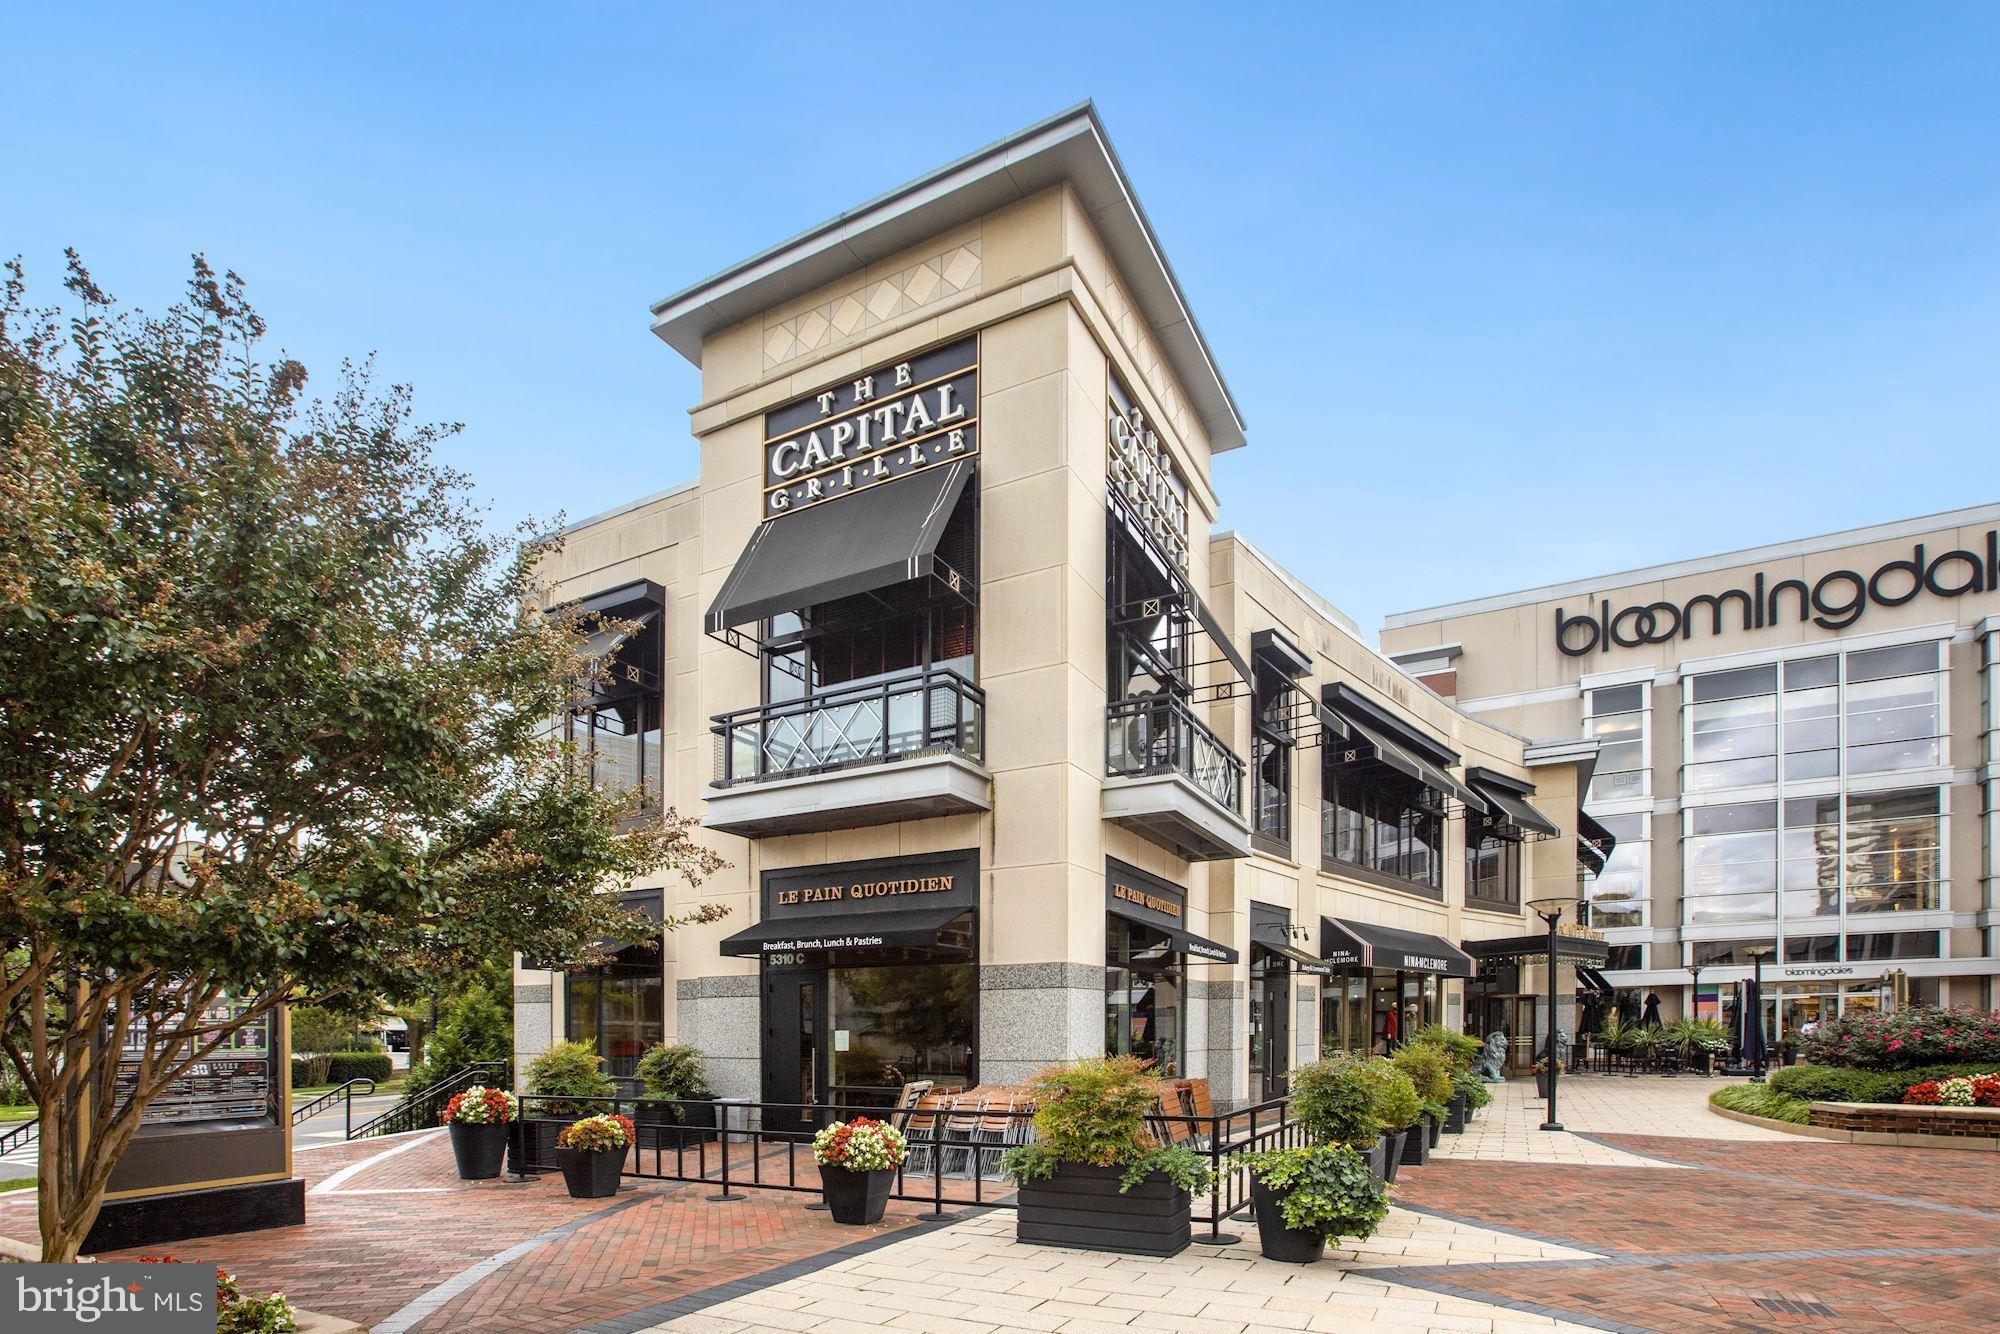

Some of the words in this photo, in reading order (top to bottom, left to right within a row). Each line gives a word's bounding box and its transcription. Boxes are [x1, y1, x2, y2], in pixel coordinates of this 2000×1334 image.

[817, 362, 912, 415] THE
[772, 383, 965, 478] CAPITAL
[1556, 530, 2000, 657] bloomingdal
[778, 891, 799, 905] LE
[803, 886, 844, 902] PAIN
[850, 876, 954, 899] QUOTIDIEN
[1114, 883, 1126, 899] LE
[1127, 887, 1145, 905] PAIN
[1146, 895, 1181, 917] QUOTIDIEN
[763, 940, 795, 951] Breakfast,
[796, 939, 822, 949] Brunch,
[823, 937, 844, 948] Lunch
[846, 937, 852, 946] &
[853, 936, 882, 946] Pastries
[770, 953, 793, 965] 5310
[796, 952, 804, 964] C
